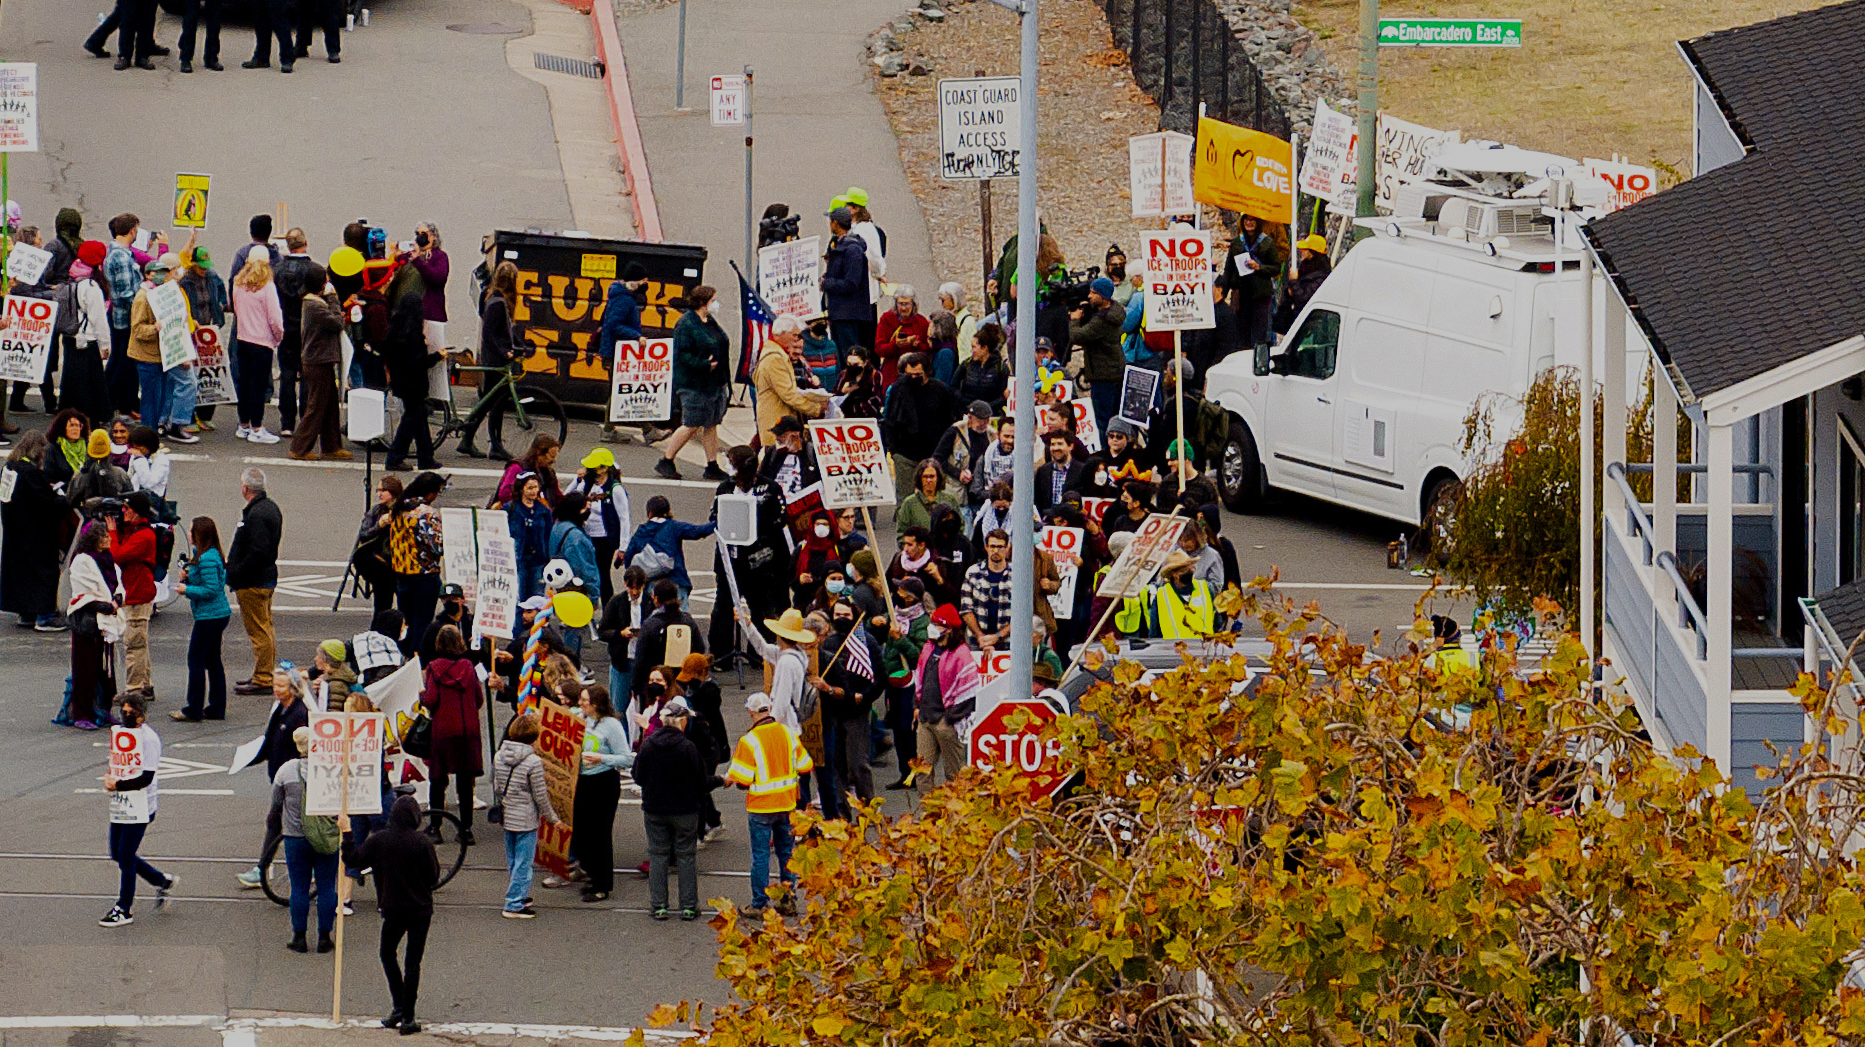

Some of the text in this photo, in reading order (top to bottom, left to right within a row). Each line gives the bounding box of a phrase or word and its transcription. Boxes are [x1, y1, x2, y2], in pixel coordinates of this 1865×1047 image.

[1399, 24, 1472, 41] Embarcadero
[1477, 24, 1501, 41] East
[719, 94, 736, 105] ANY
[945, 87, 1017, 106] COAST GUARD
[718, 109, 738, 121] TIME
[958, 110, 1004, 126] ISLAND
[958, 132, 1007, 147] ACCESS
[1253, 167, 1291, 194] LOVE
[1149, 238, 1204, 258] NO
[1147, 257, 1207, 272] ICE TROOPS
[1153, 282, 1206, 296] BAY!
[7, 299, 51, 320] NO
[17, 318, 51, 334] TROOPS
[1, 340, 45, 356] BAY!
[621, 342, 668, 360] NO
[199, 366, 227, 378] AY!
[616, 359, 670, 373] ICE TROOPS
[618, 383, 667, 395] BAY!
[815, 425, 873, 443] NO
[817, 441, 880, 456] ICE TROOPS
[827, 462, 882, 477] BAY!
[541, 706, 586, 745] LEAVE
[540, 729, 575, 767] OUR
